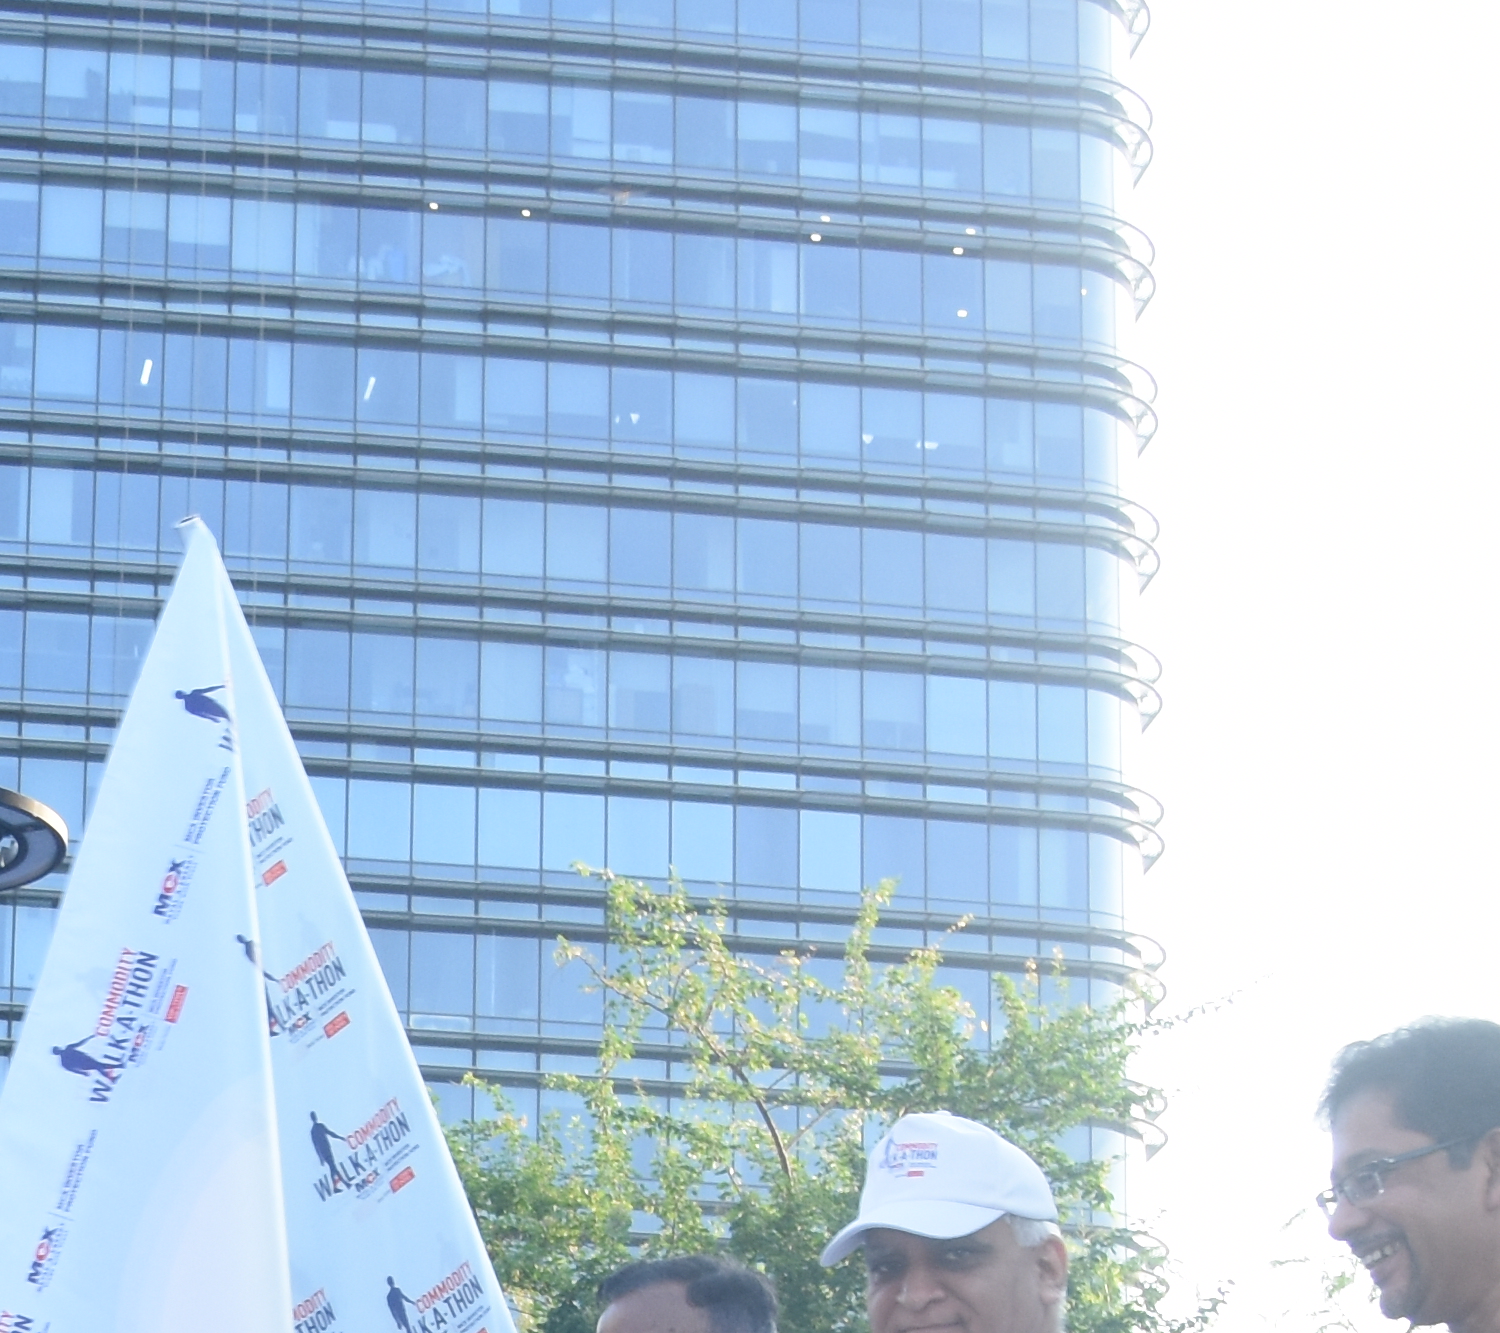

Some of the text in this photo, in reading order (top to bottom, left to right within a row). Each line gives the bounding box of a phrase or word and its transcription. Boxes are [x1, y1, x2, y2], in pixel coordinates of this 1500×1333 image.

[96, 947, 136, 1038] COMMODITY
[346, 1097, 399, 1151] COMMODITY
[416, 1260, 473, 1315] COMMODITY
